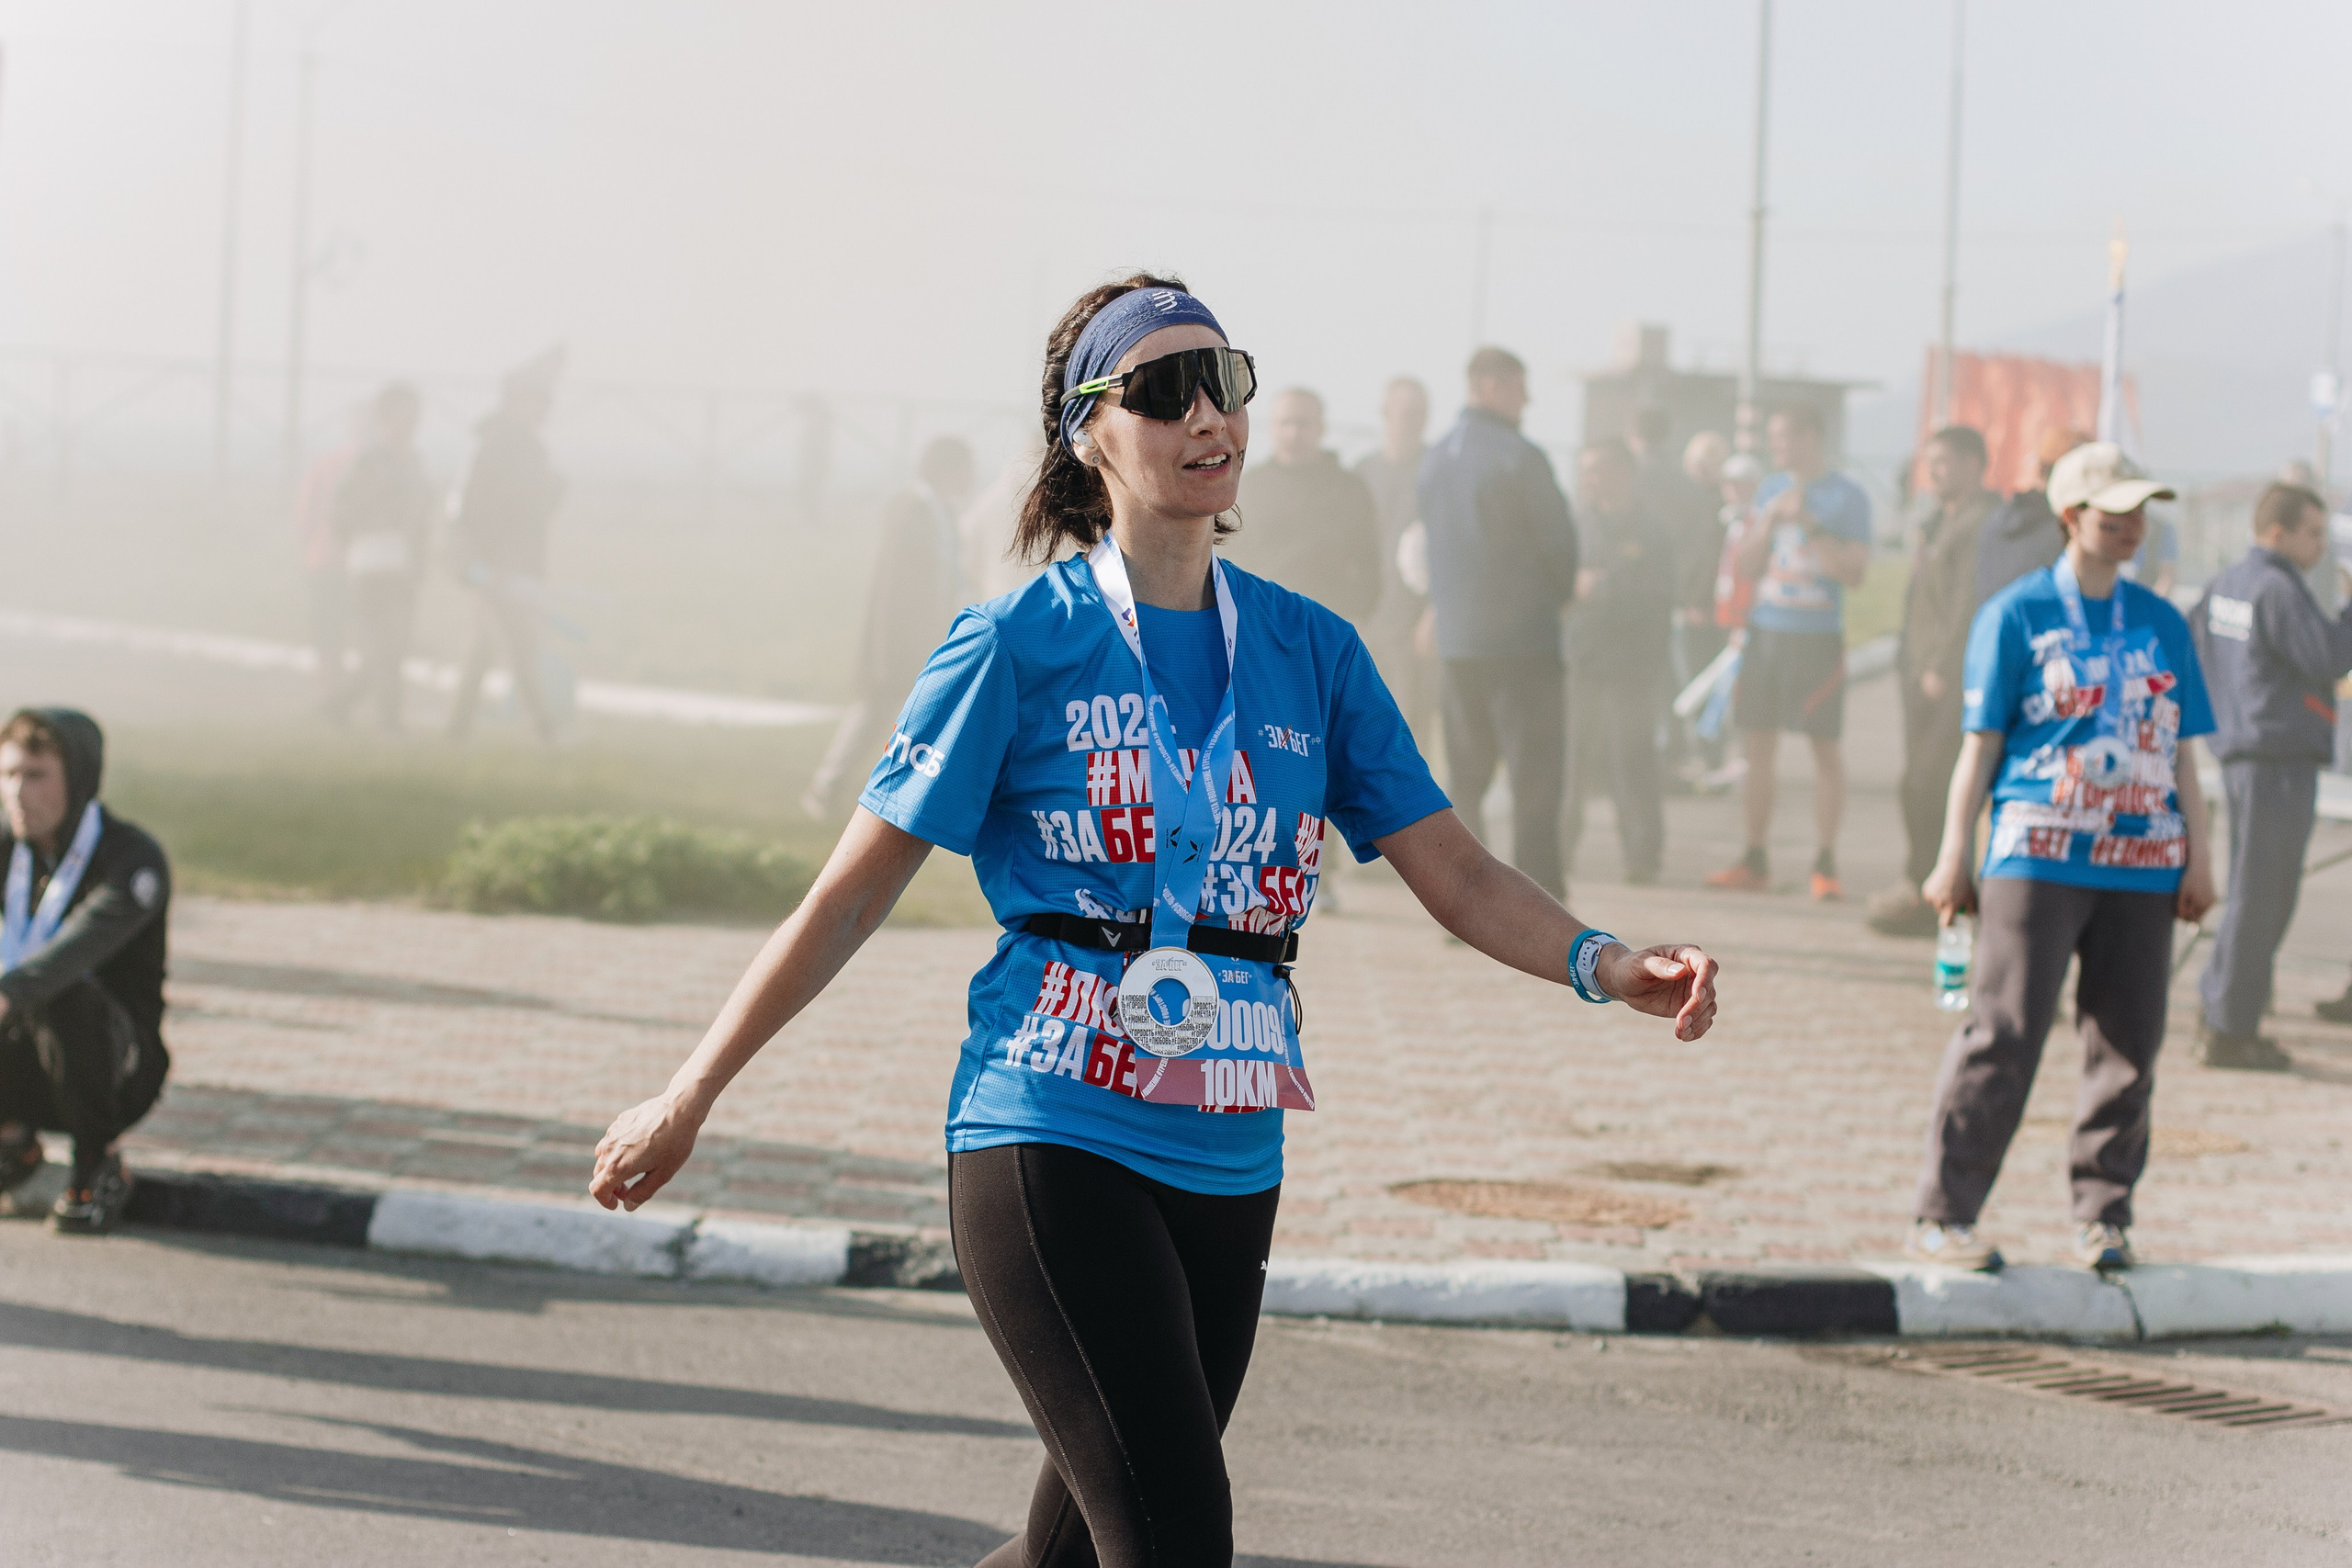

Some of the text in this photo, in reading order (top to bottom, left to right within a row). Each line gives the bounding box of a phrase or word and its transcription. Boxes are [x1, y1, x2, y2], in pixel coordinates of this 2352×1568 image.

[1066, 693, 1177, 751] 202
[887, 731, 945, 778] ПСБ
[1087, 748, 1257, 807] #МА
[1169, 762, 1189, 795] #ЕДИНСТ
[1032, 806, 1156, 863] #ЗАБЕ
[1209, 806, 1277, 864] 024
[1197, 998, 1284, 1055] 0009
[1005, 1015, 1138, 1098] #ЗАБЕ
